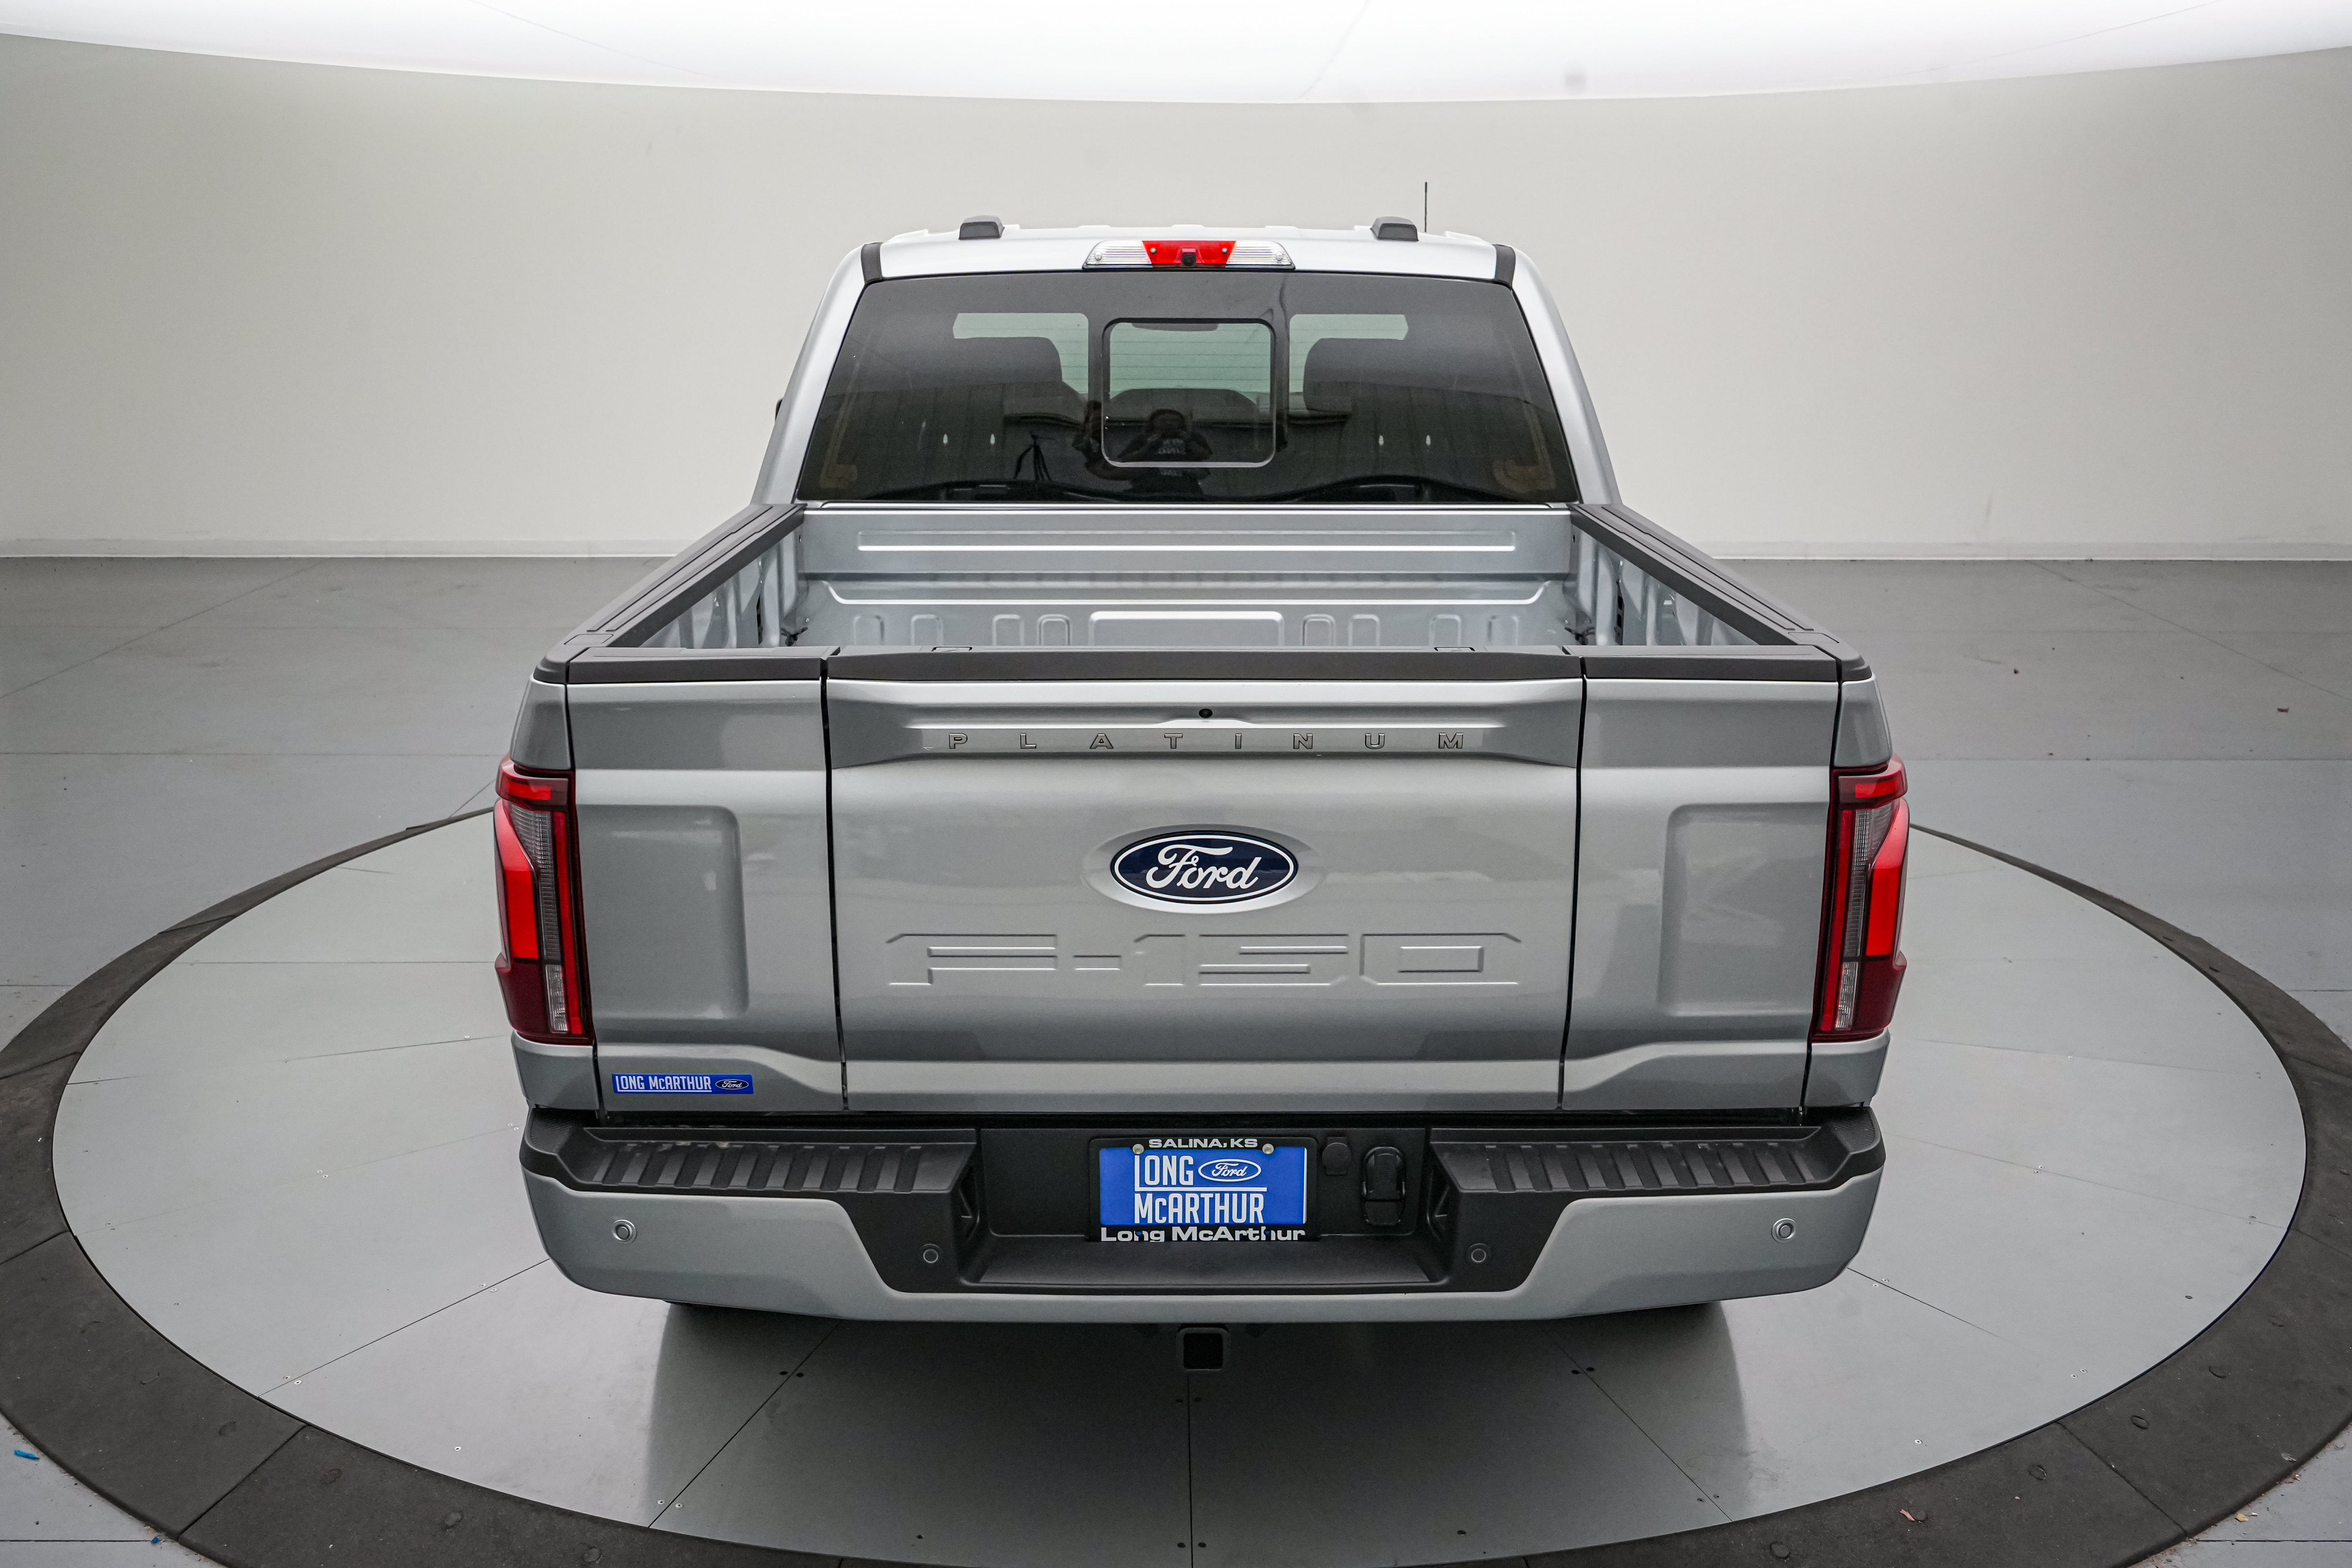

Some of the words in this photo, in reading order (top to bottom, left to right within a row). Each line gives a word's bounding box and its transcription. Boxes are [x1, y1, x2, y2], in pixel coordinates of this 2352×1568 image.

[948, 732, 1463, 750] PLATINUM
[1146, 844, 1262, 889] Ford
[615, 1076, 644, 1091] LONG
[648, 1076, 711, 1089] McARTHUR
[1149, 1138, 1227, 1148] SALINA,
[1231, 1138, 1258, 1148] KS
[1134, 1155, 1194, 1192] LONG
[1211, 1163, 1247, 1177] Ford
[1134, 1193, 1264, 1223] McARTHUR
[1101, 1227, 1165, 1242] Long
[1172, 1226, 1305, 1241] McArthur
